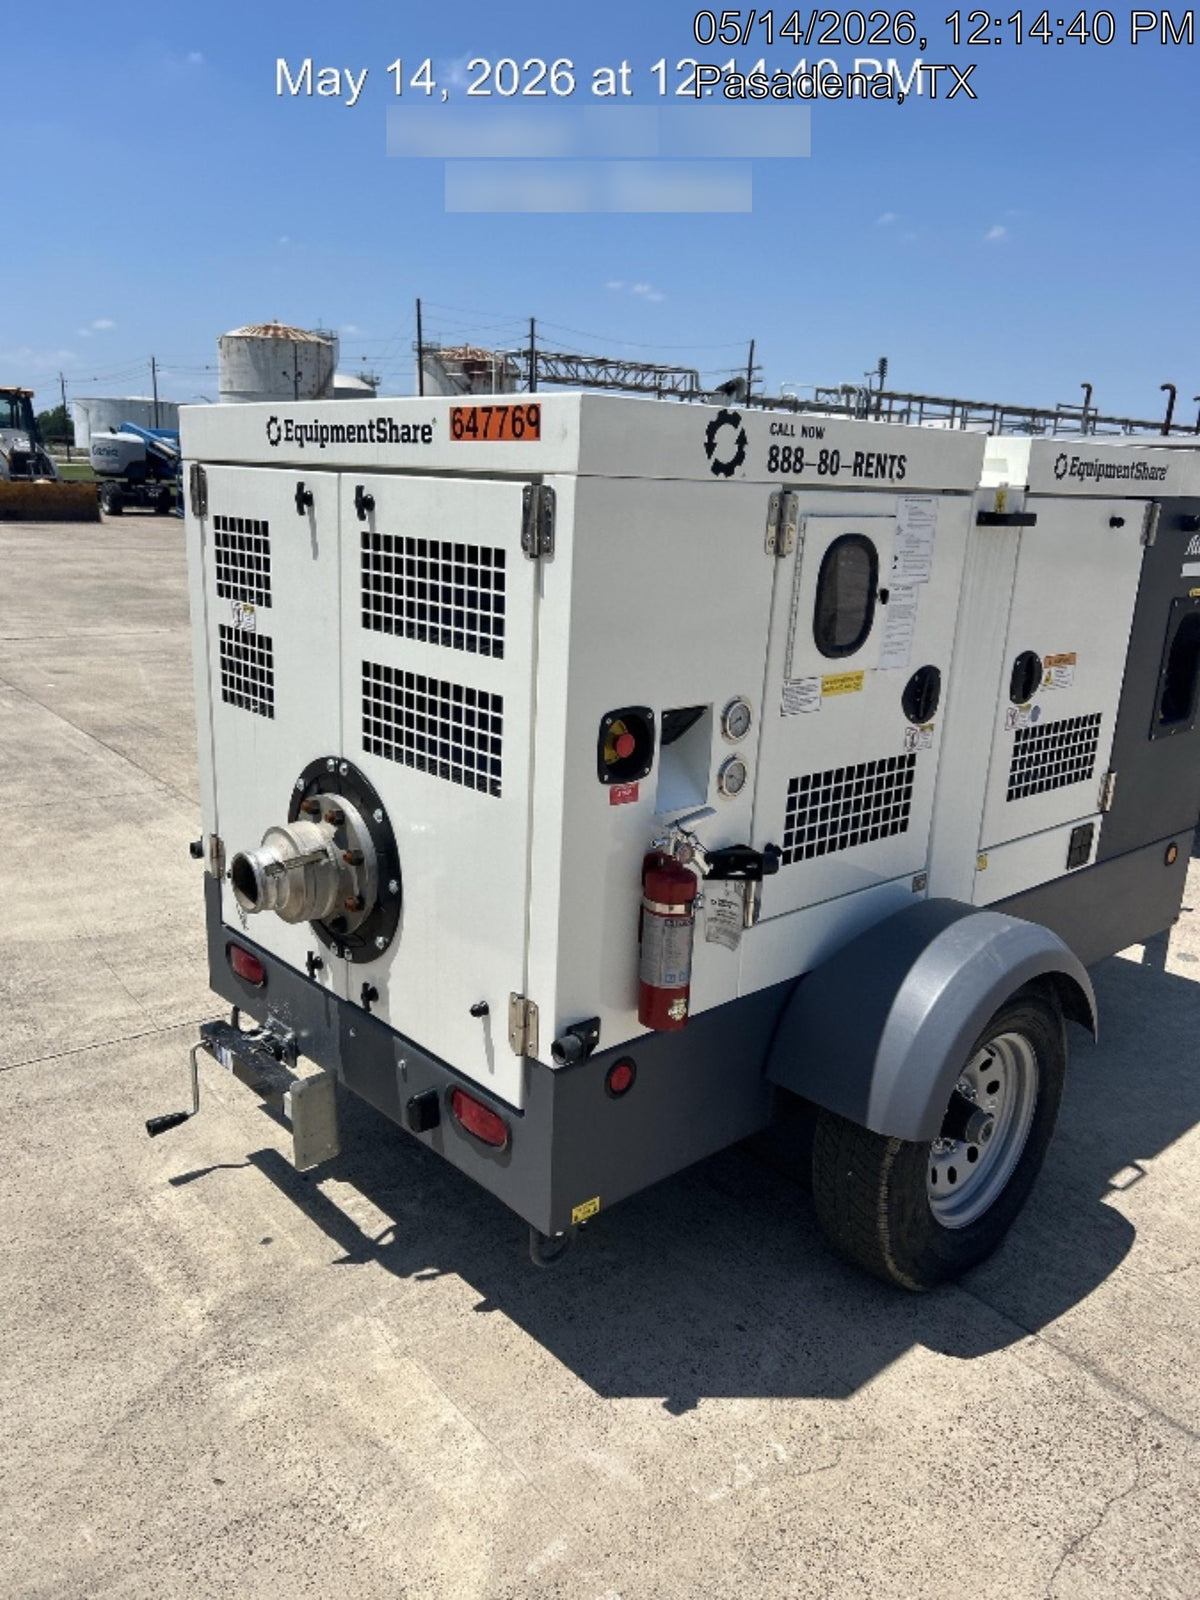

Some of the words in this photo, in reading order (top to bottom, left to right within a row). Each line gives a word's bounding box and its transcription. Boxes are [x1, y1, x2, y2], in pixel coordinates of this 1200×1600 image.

[283, 417, 433, 448] EquipmentShare
[452, 404, 540, 439] 647769
[769, 422, 796, 437] CALL
[801, 424, 826, 440] NOW
[767, 444, 907, 480] 888-80-RENTS
[1068, 456, 1168, 482] EquipmentShare
